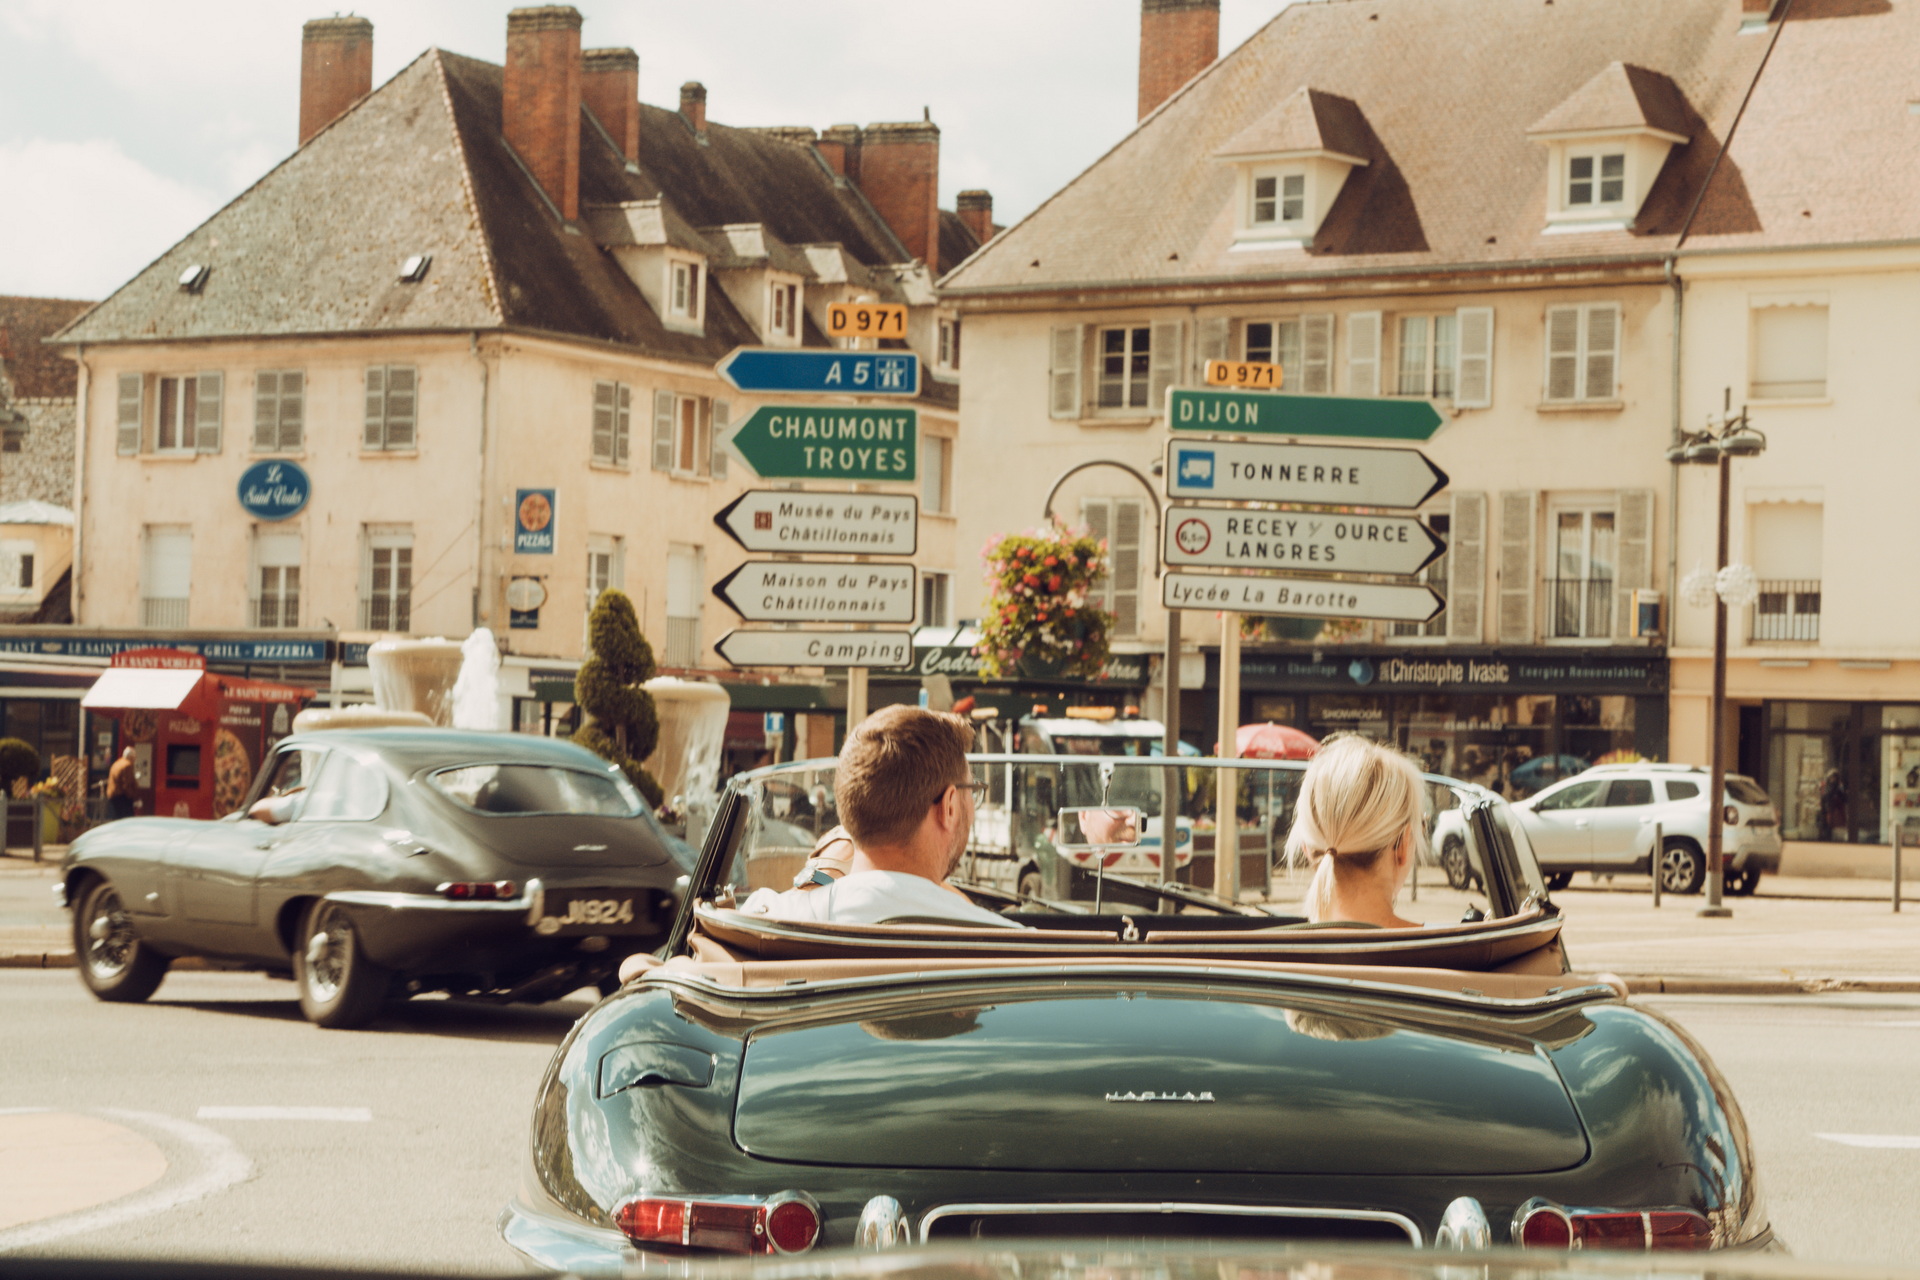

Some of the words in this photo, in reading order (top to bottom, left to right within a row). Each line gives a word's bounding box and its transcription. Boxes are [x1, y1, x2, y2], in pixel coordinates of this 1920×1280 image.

[832, 309, 847, 331] D
[856, 309, 903, 332] 971
[825, 361, 842, 384] A
[853, 361, 870, 385] 5
[1217, 364, 1228, 381] D
[1236, 365, 1274, 383] 971
[1179, 399, 1259, 424] DIJON
[769, 416, 907, 441] CHAUMONT
[804, 447, 907, 472] TROYES
[1231, 462, 1359, 484] TONNERRE
[779, 502, 834, 518] Musée
[843, 504, 862, 520] du
[871, 506, 910, 523] Pays
[518, 533, 551, 548] PIZZAS
[779, 526, 895, 543] Châtillonnais
[1227, 517, 1297, 537] RECEY
[1335, 523, 1409, 543] OURCE
[1226, 541, 1336, 562] LANGRES
[762, 573, 827, 588] Maison
[838, 574, 857, 588] du
[867, 575, 908, 591] Pays
[762, 595, 886, 611] Châtillonnais
[1172, 583, 1230, 603] Lycée
[1243, 585, 1264, 602] La
[1277, 587, 1358, 608] Barotte
[204, 643, 242, 658] GRILL
[253, 644, 314, 658] PIZZERIA
[808, 640, 904, 661] Camping
[1390, 658, 1464, 687] Christophe
[1468, 659, 1510, 683] Ivasic
[1322, 708, 1383, 720] SHOWROOM
